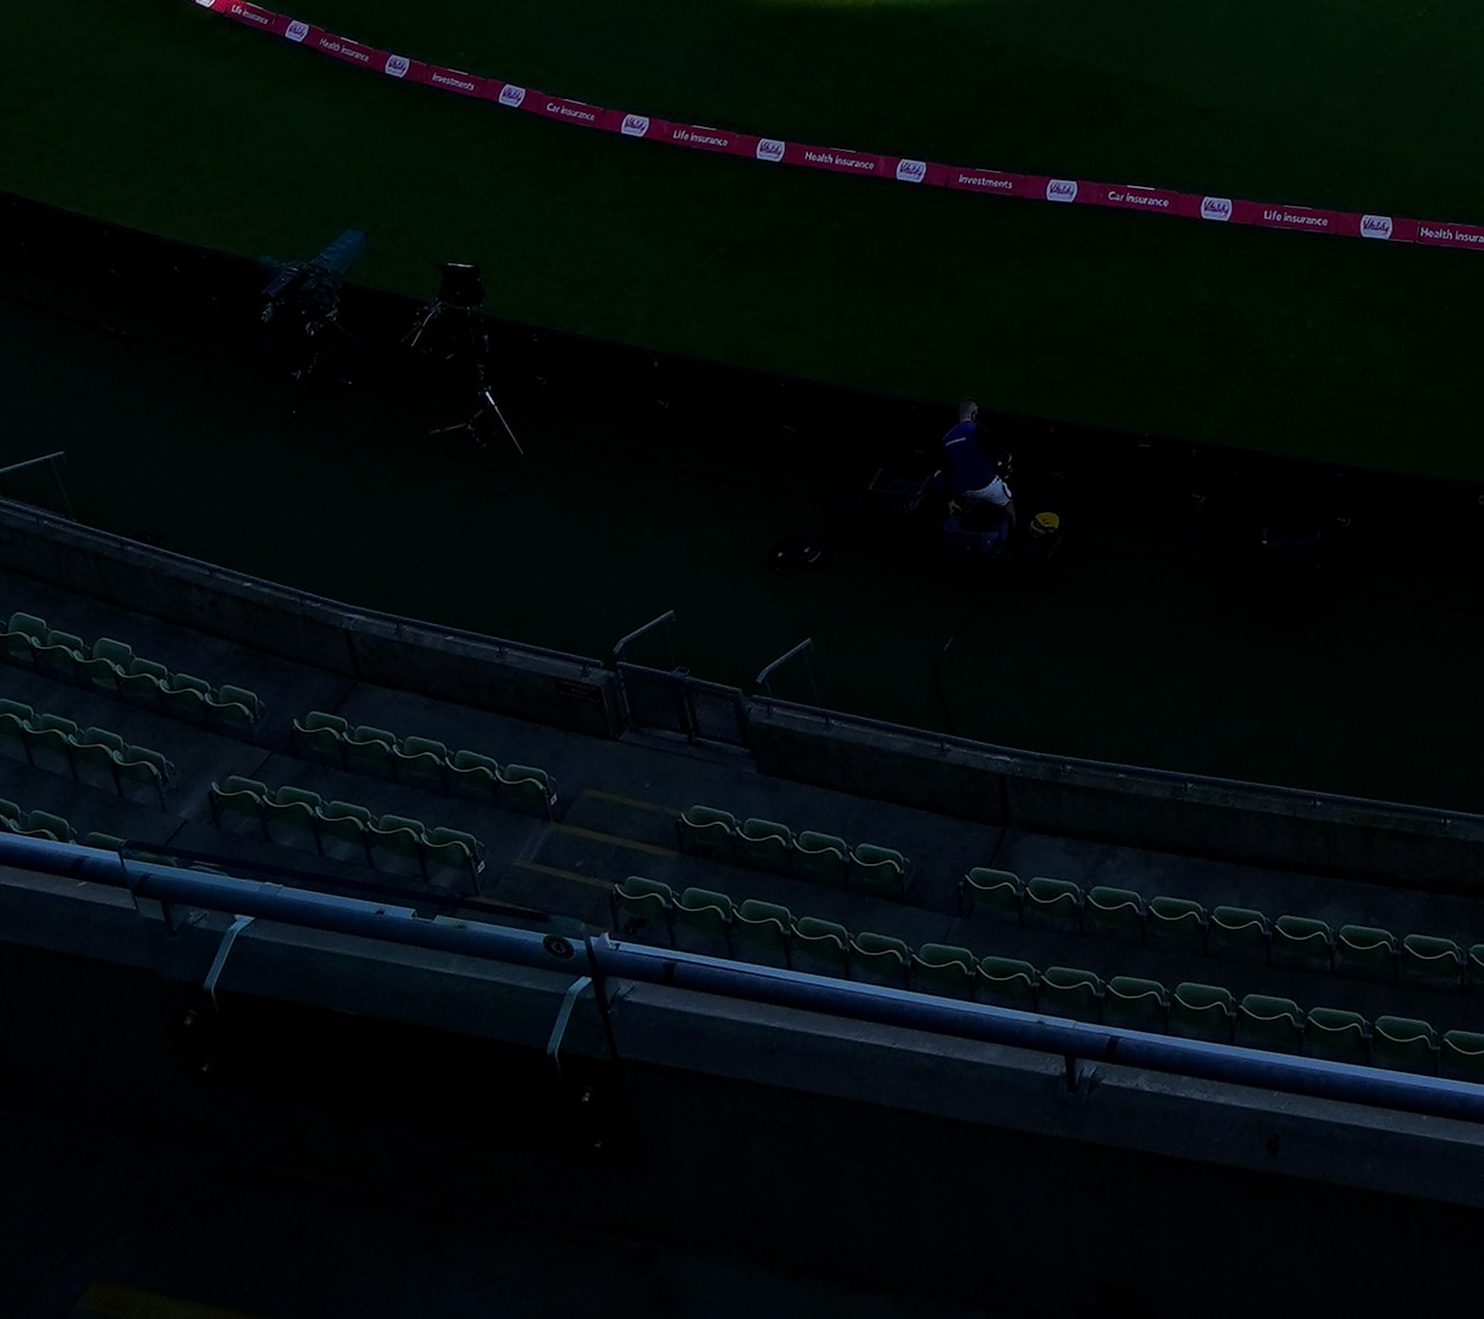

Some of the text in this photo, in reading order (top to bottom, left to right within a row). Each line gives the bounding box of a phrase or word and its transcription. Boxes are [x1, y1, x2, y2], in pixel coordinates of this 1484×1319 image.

[1263, 210, 1328, 227] Life insurance
[1420, 226, 1453, 241] Health
